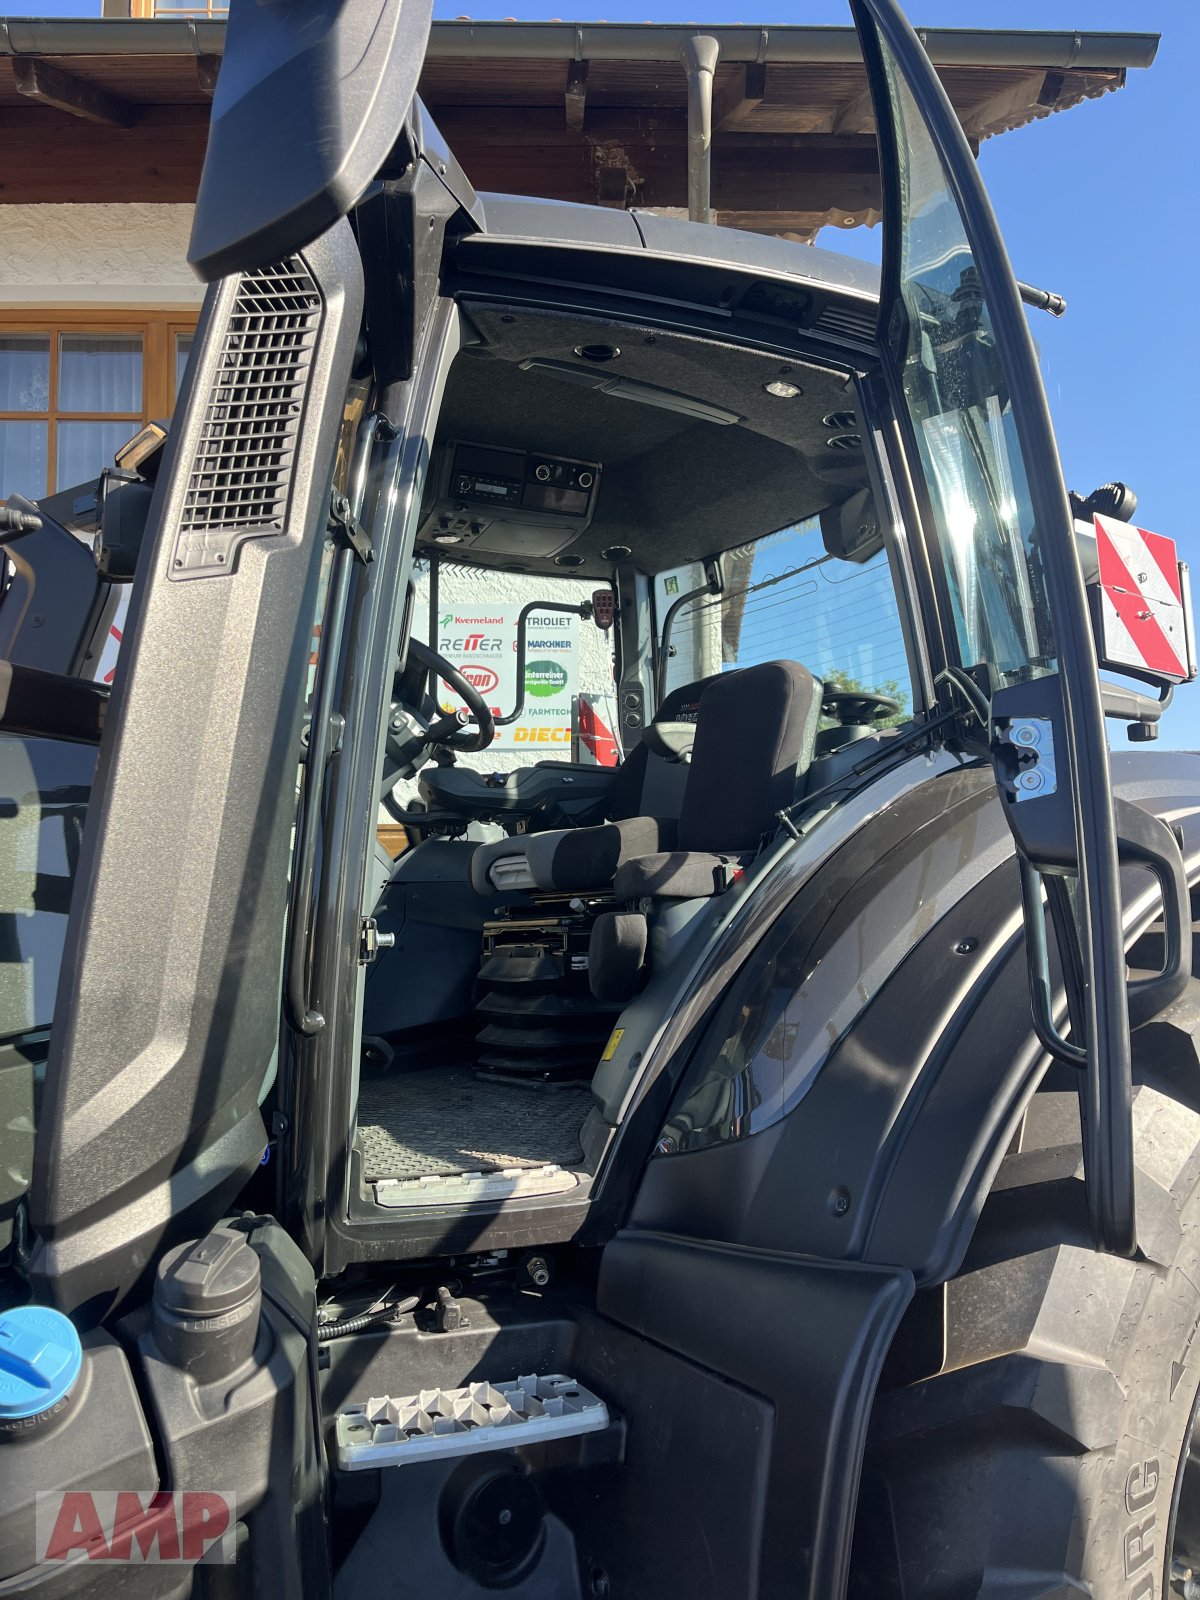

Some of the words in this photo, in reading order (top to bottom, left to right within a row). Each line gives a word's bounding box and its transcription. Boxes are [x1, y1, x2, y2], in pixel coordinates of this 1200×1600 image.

[455, 616, 504, 624] Kverneland
[526, 617, 572, 626] TRIOLIET
[440, 634, 503, 651] REITER
[527, 640, 571, 649] MARCHNER
[525, 671, 564, 679] interreiner
